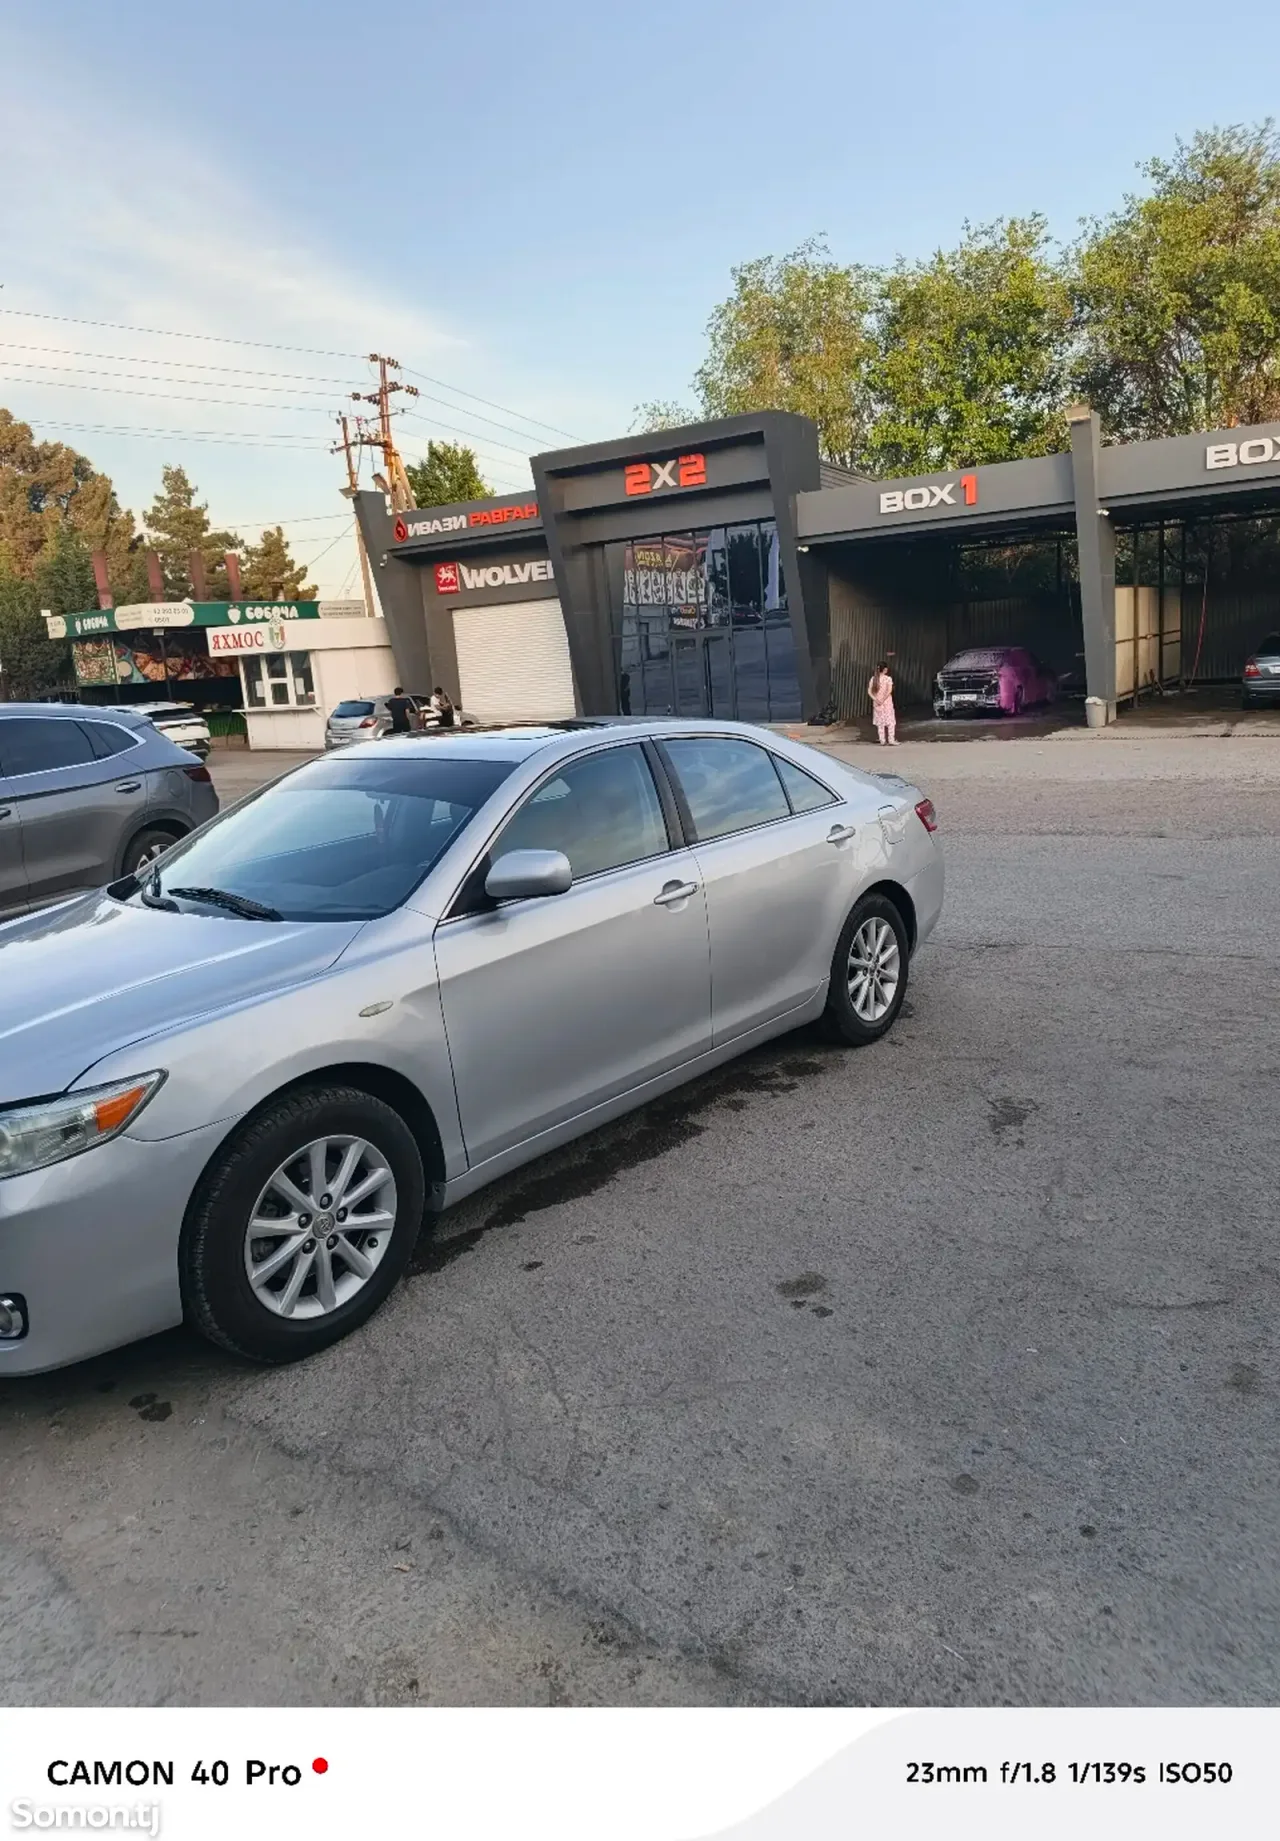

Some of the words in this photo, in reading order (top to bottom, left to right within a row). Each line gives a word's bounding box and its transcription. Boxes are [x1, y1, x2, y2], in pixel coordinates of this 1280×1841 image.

[880, 482, 957, 514] BOX
[960, 475, 977, 505] 1
[407, 514, 468, 537] ИВАЗИ
[211, 631, 264, 651] ЯХМОС
